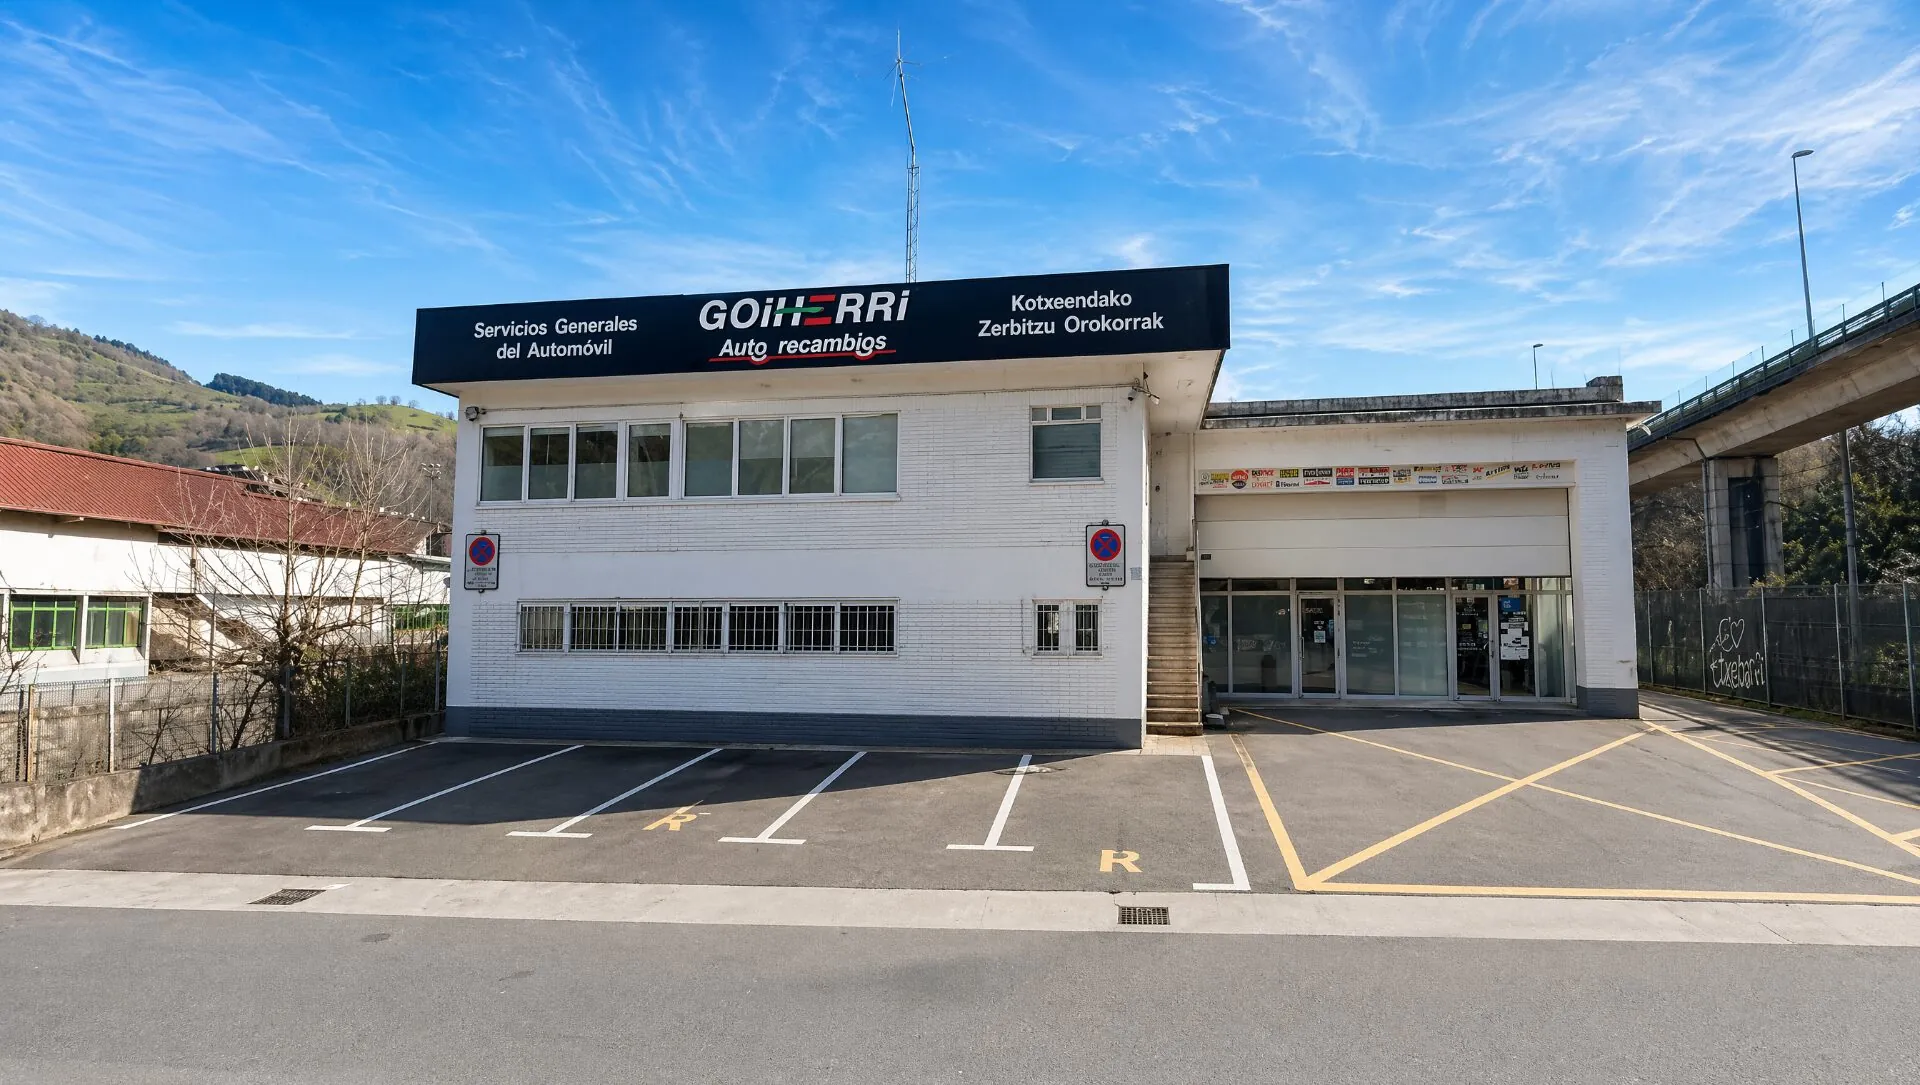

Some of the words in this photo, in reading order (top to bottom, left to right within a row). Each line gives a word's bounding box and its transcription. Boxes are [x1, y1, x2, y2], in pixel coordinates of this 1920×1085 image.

[1010, 289, 1133, 312] Kotxeendako
[474, 321, 548, 339] Servicios
[554, 315, 638, 335] Generales
[978, 318, 1056, 338] Zerbitzu
[1064, 311, 1164, 334] Orokorrak
[496, 342, 521, 360] del
[526, 338, 613, 358] Automóvil
[718, 338, 768, 362] Auto
[777, 332, 888, 357] recambios
[1099, 849, 1144, 873] R
